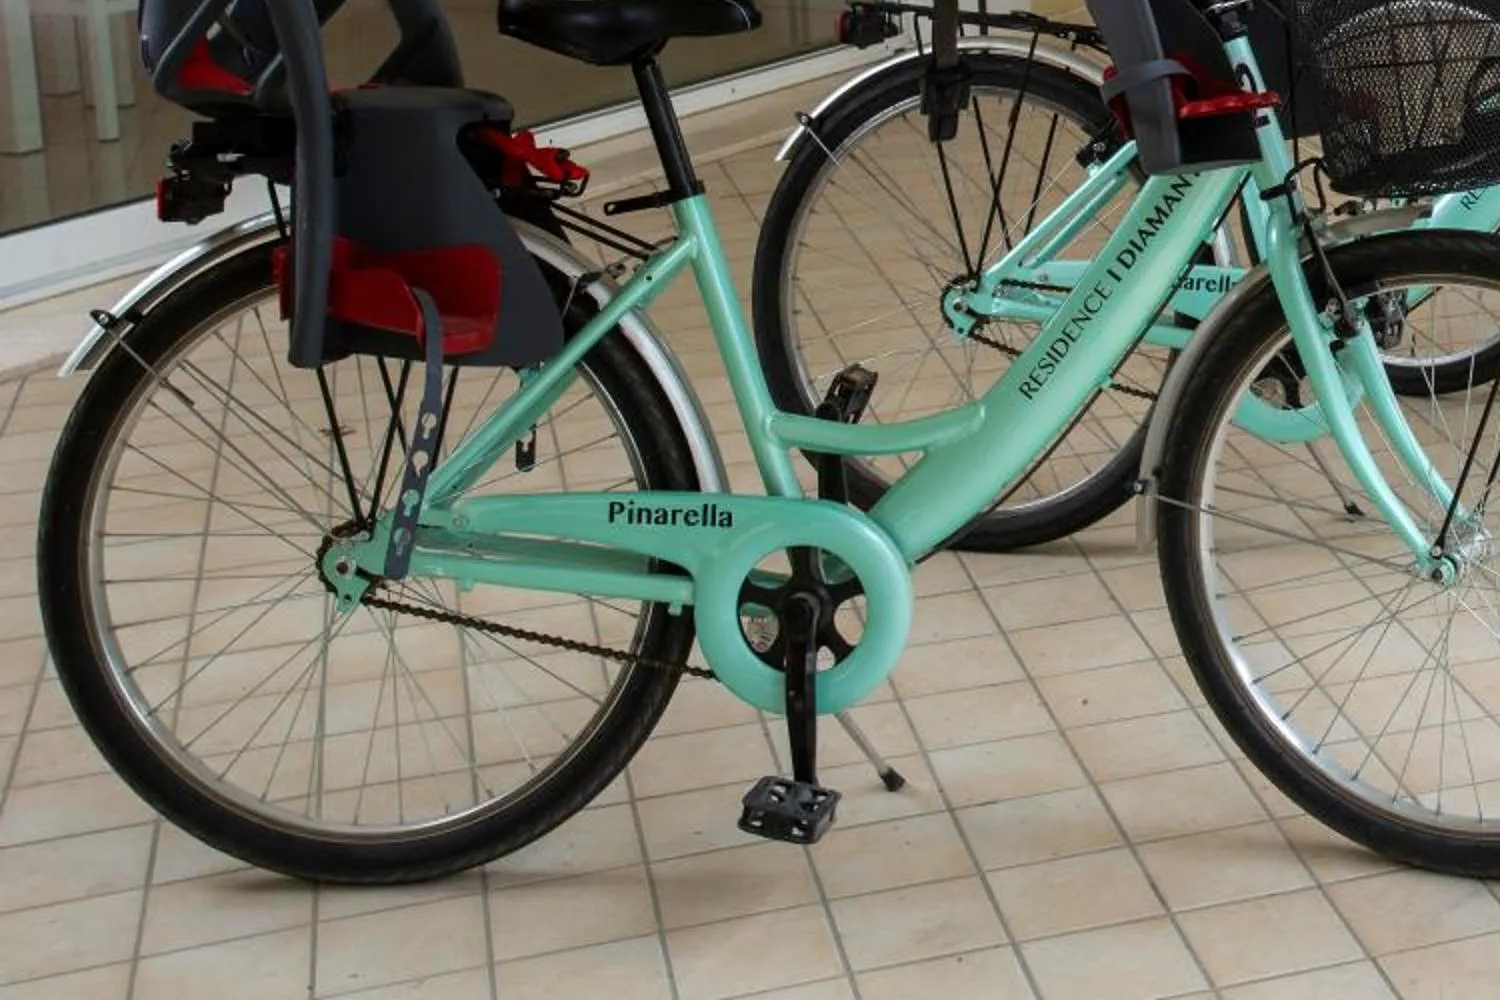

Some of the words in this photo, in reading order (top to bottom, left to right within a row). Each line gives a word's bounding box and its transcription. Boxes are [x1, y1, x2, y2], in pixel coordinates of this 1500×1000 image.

[1018, 281, 1112, 400] RESIDENCE
[1106, 267, 1123, 283] I
[1116, 172, 1201, 271] DIAMAN
[1183, 275, 1238, 293] arell
[608, 500, 733, 528] Pinarella
